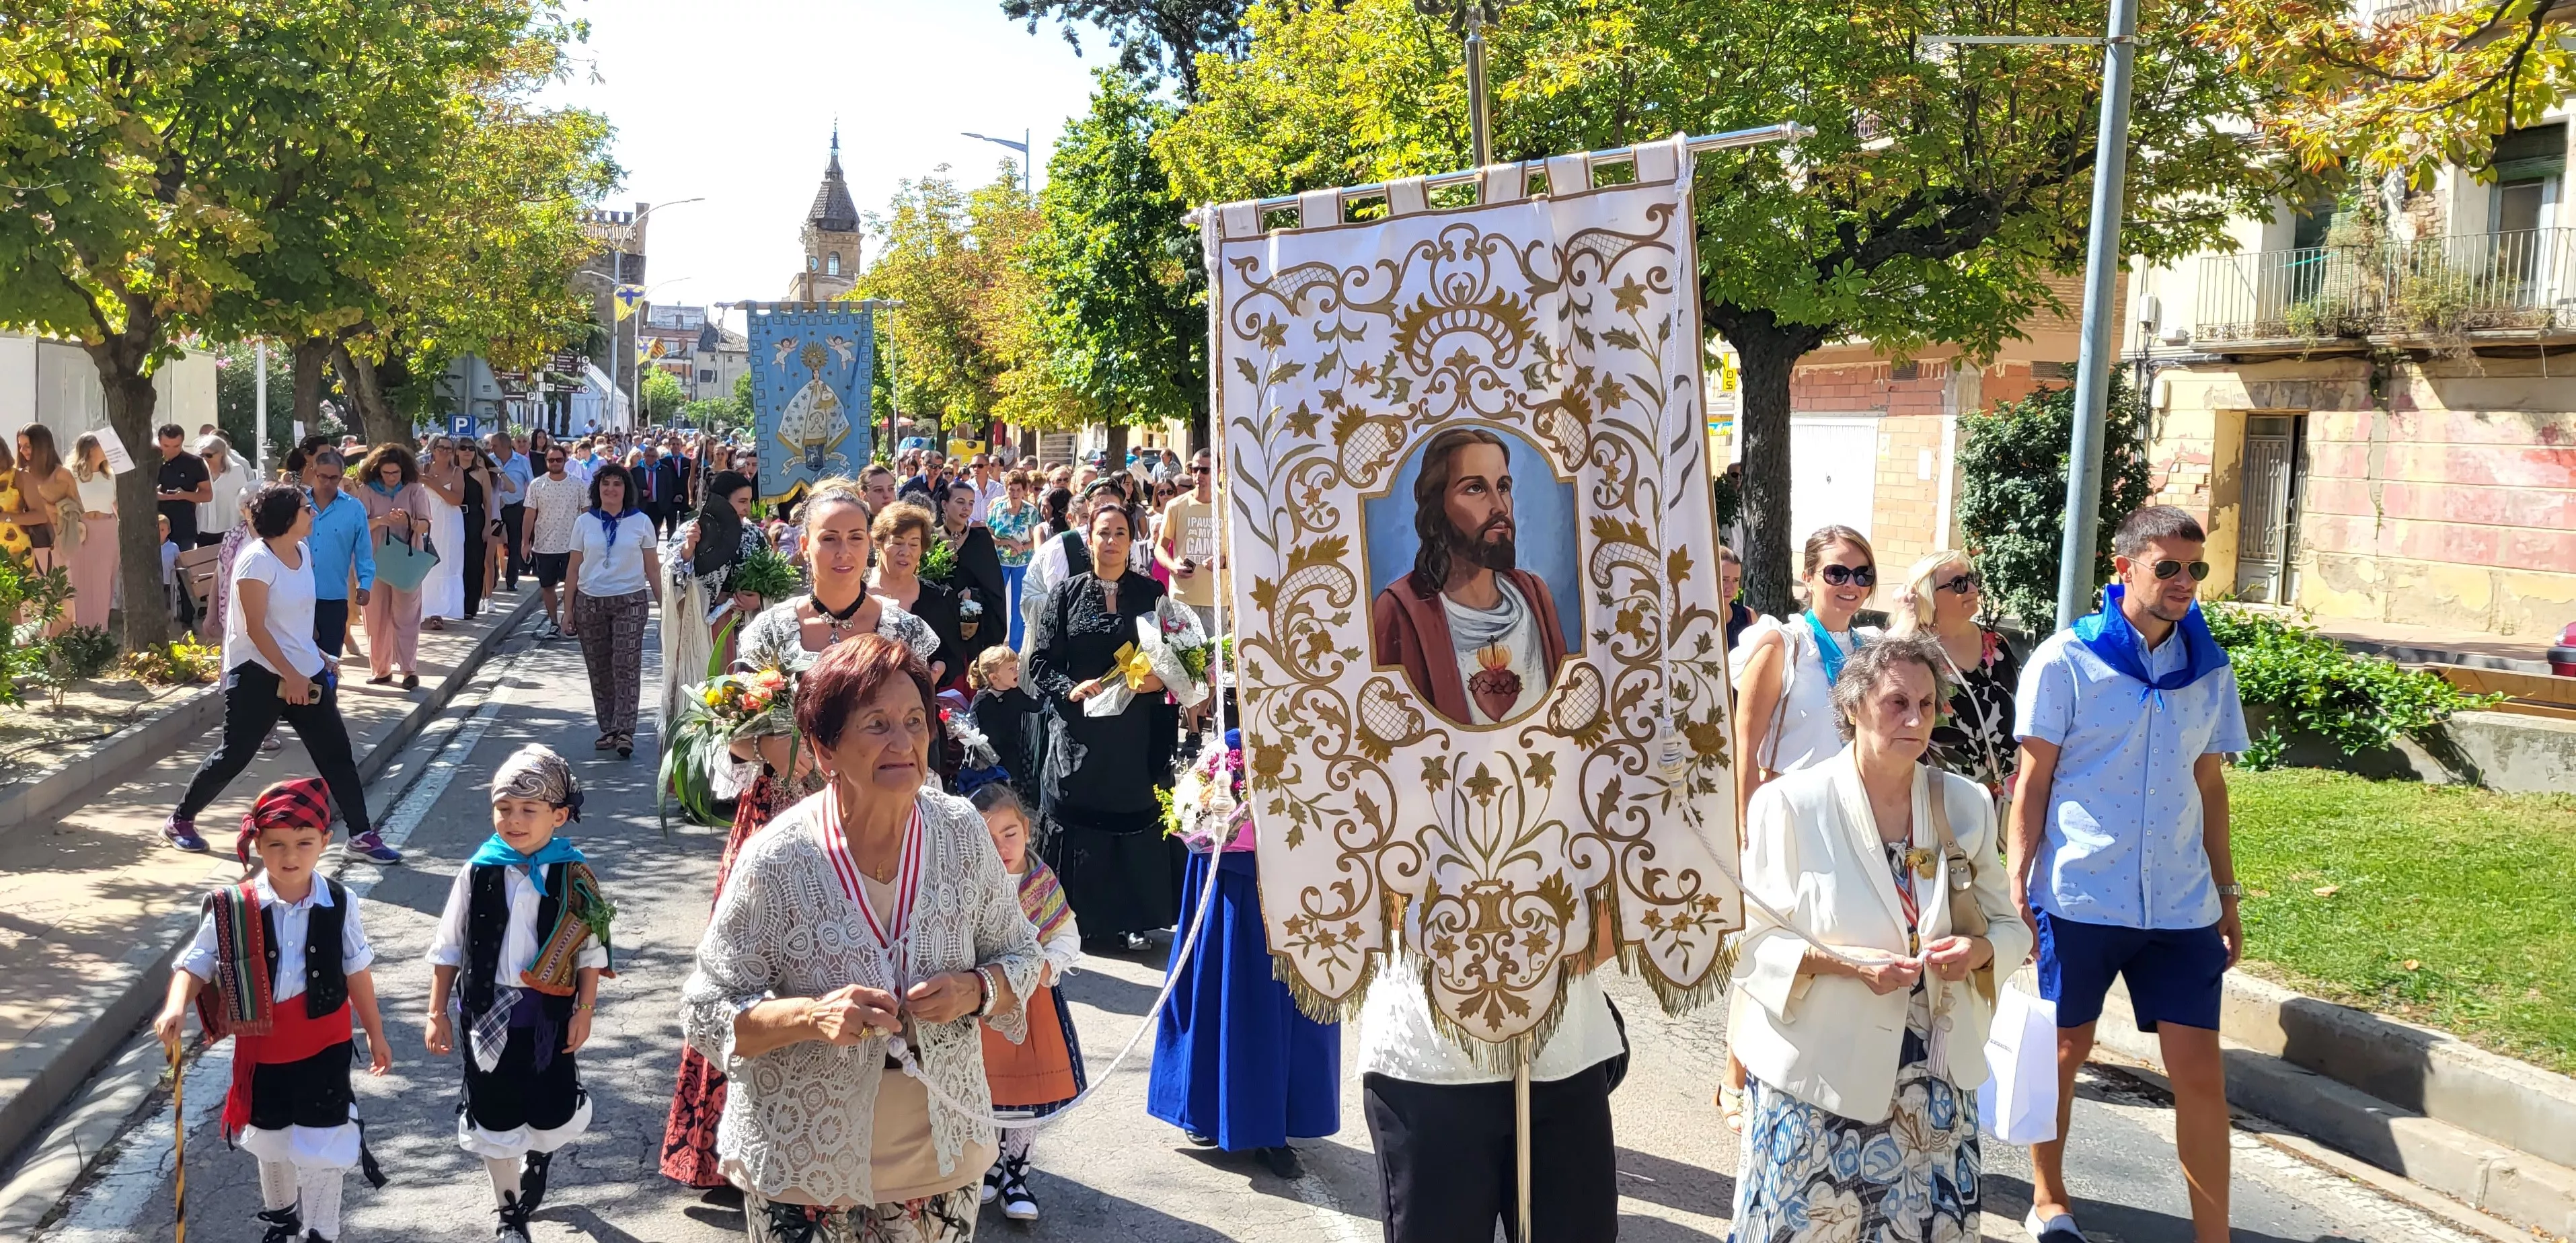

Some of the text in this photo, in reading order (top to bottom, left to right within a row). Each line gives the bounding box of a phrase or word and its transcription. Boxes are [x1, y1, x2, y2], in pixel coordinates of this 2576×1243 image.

[455, 417, 469, 433] P
[1191, 517, 1223, 529] PAUSD
[1186, 537, 1221, 555] GAM
